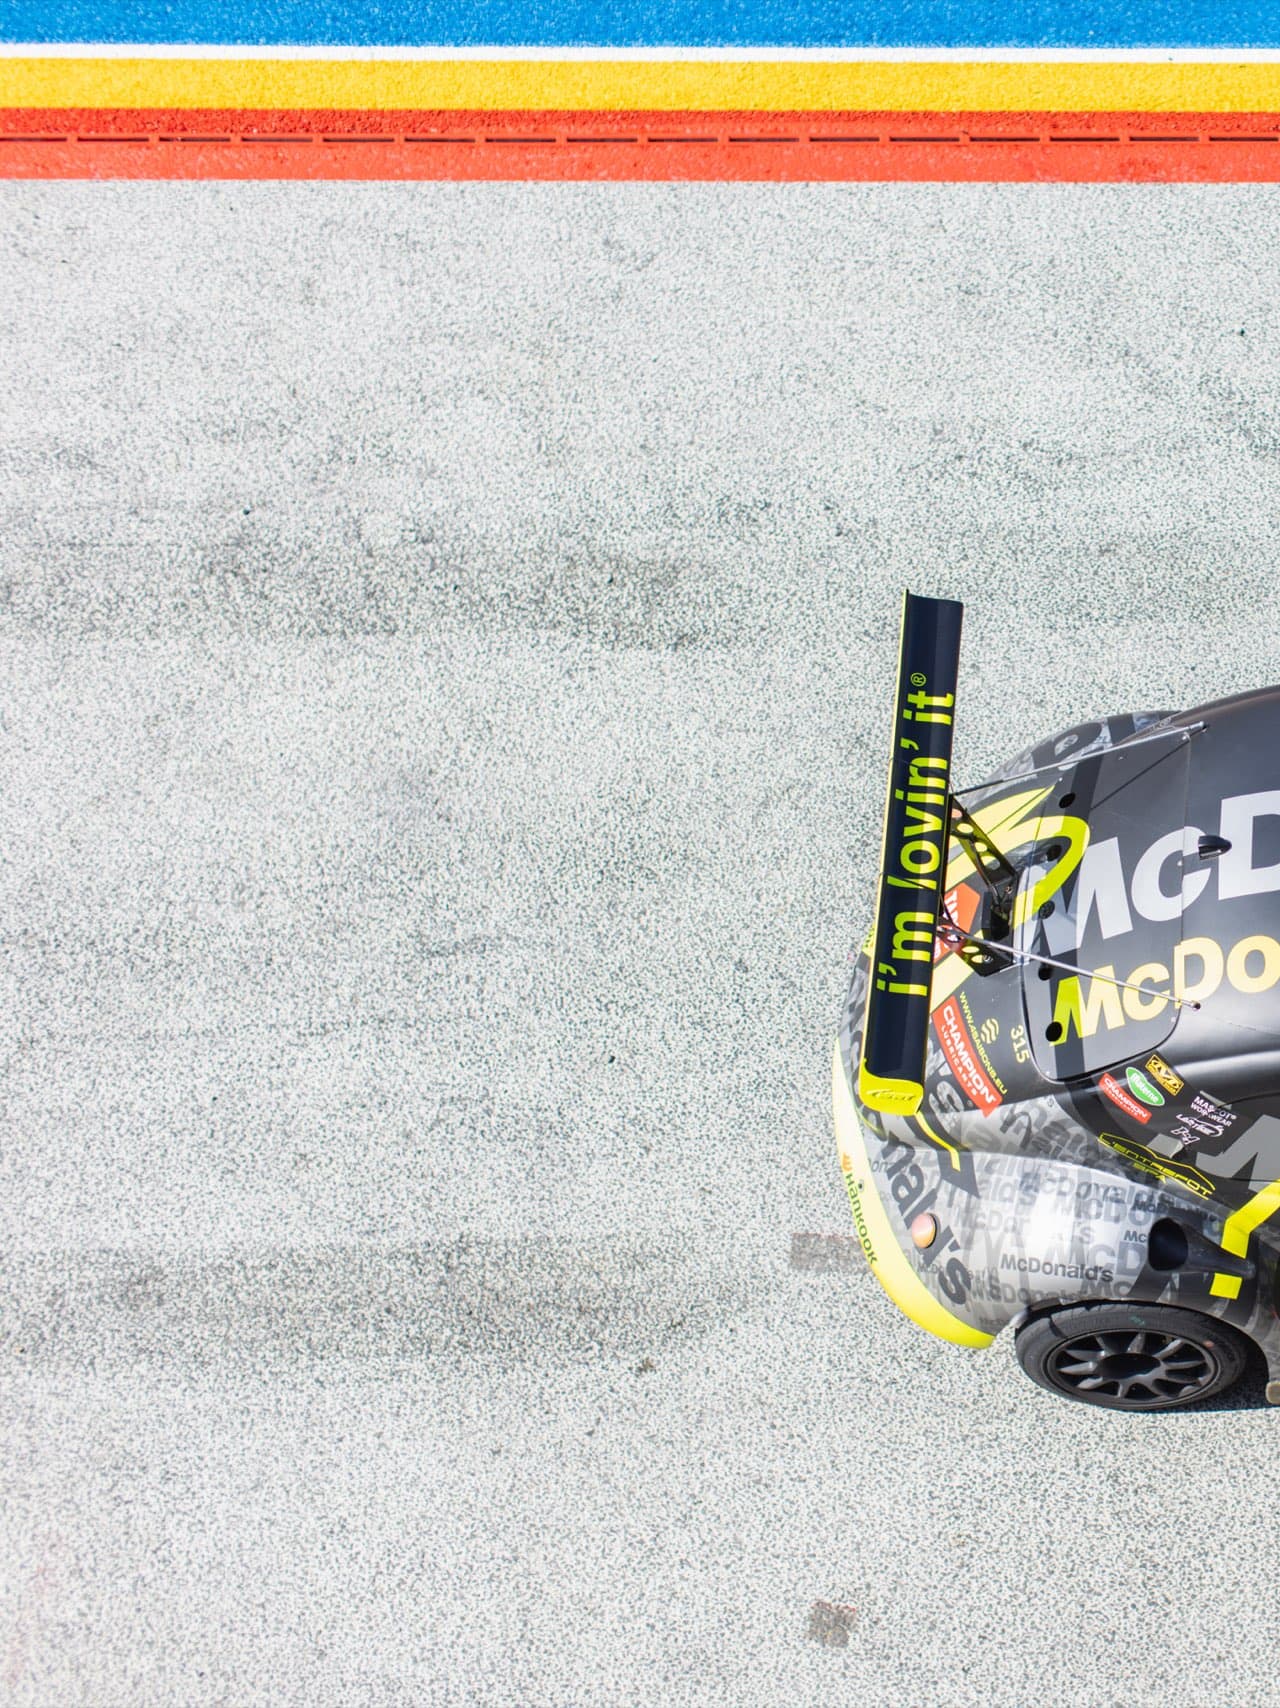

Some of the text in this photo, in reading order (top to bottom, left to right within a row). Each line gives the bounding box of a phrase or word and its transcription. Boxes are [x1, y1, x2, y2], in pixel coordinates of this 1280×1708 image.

[886, 736, 948, 891] lovin'
[875, 911, 935, 997] i'm
[941, 1025, 978, 1096] LUBRICANTS
[943, 1005, 997, 1104] CHAMPION
[1010, 1025, 1031, 1064] 315
[1104, 1077, 1149, 1119] CHAMPION
[1000, 1252, 1115, 1284] McDonald's
